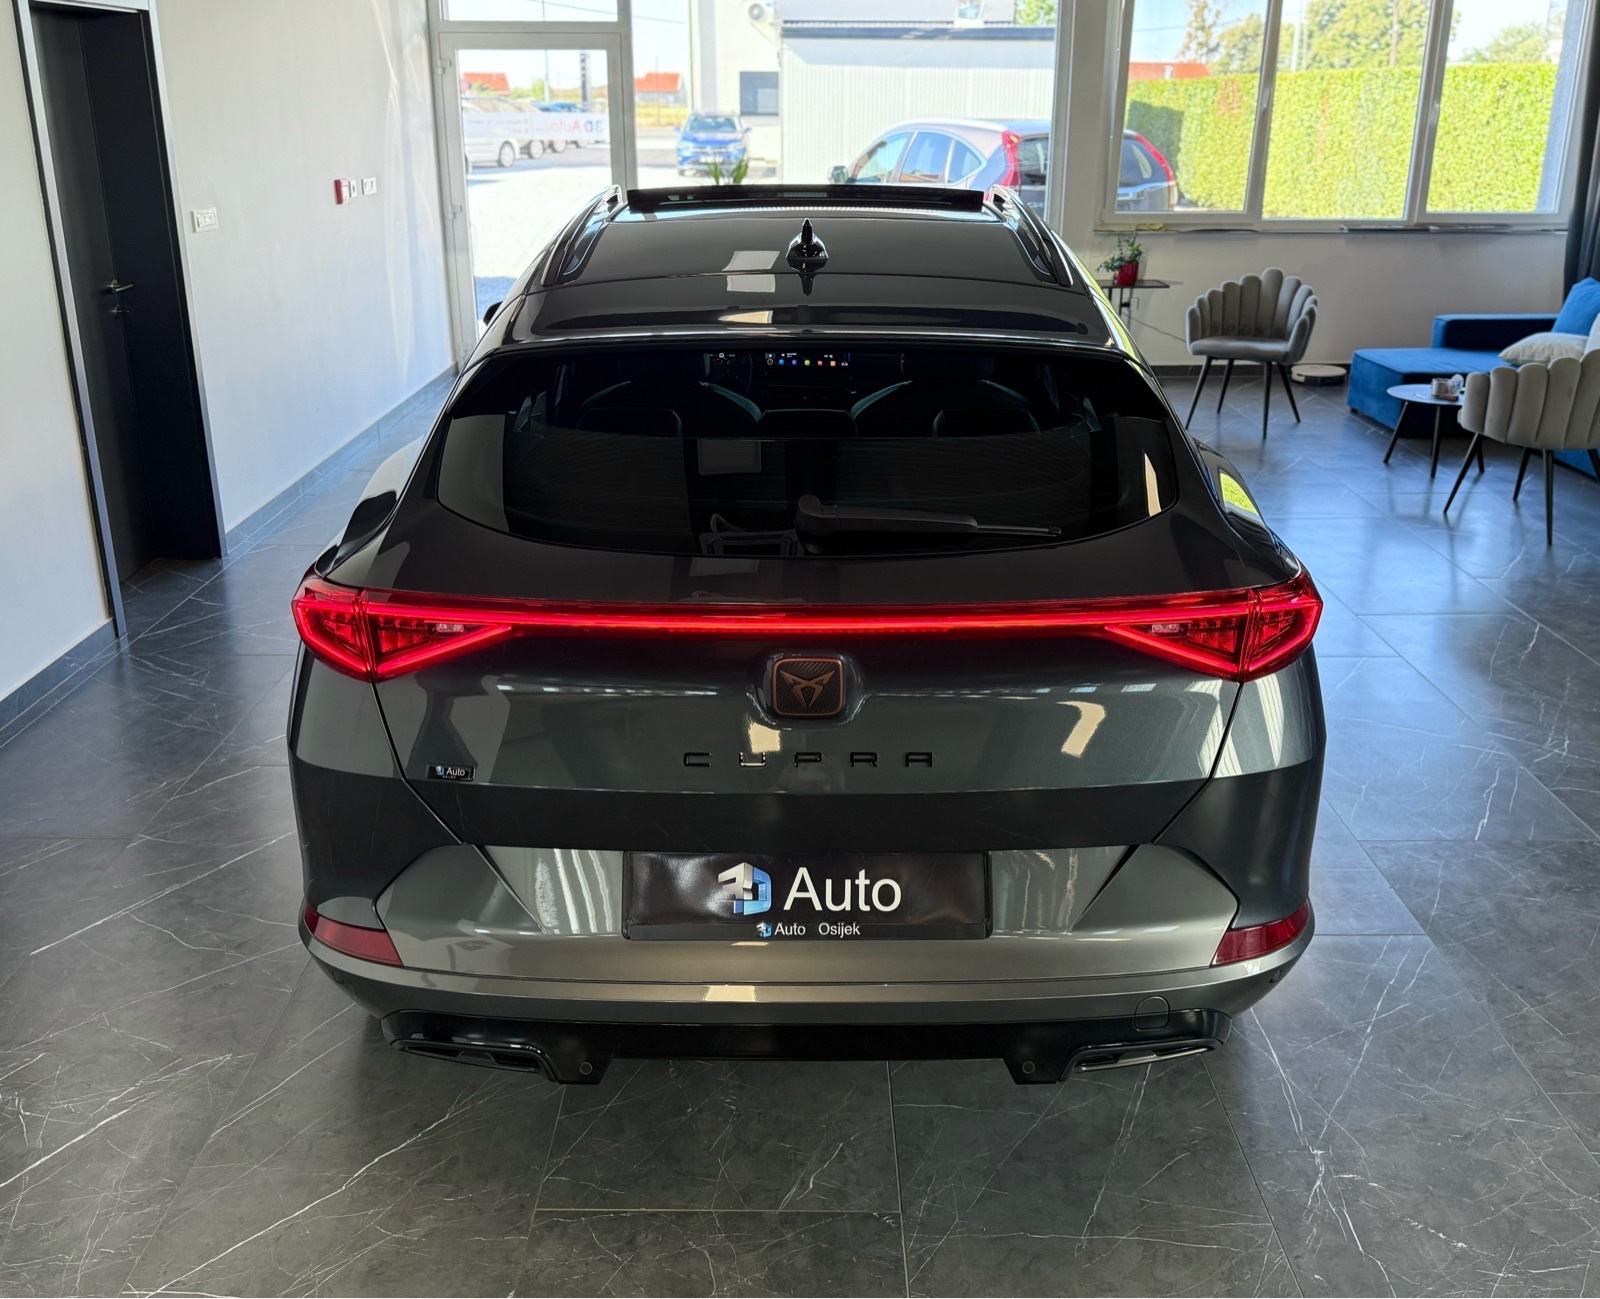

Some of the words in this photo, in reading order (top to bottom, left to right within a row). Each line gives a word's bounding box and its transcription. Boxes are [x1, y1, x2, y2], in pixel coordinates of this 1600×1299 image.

[684, 752, 933, 768] CUPRA
[446, 766, 465, 776] Auto
[783, 866, 902, 912] Auto
[774, 922, 806, 936] Auto
[818, 922, 861, 938] Osijek
